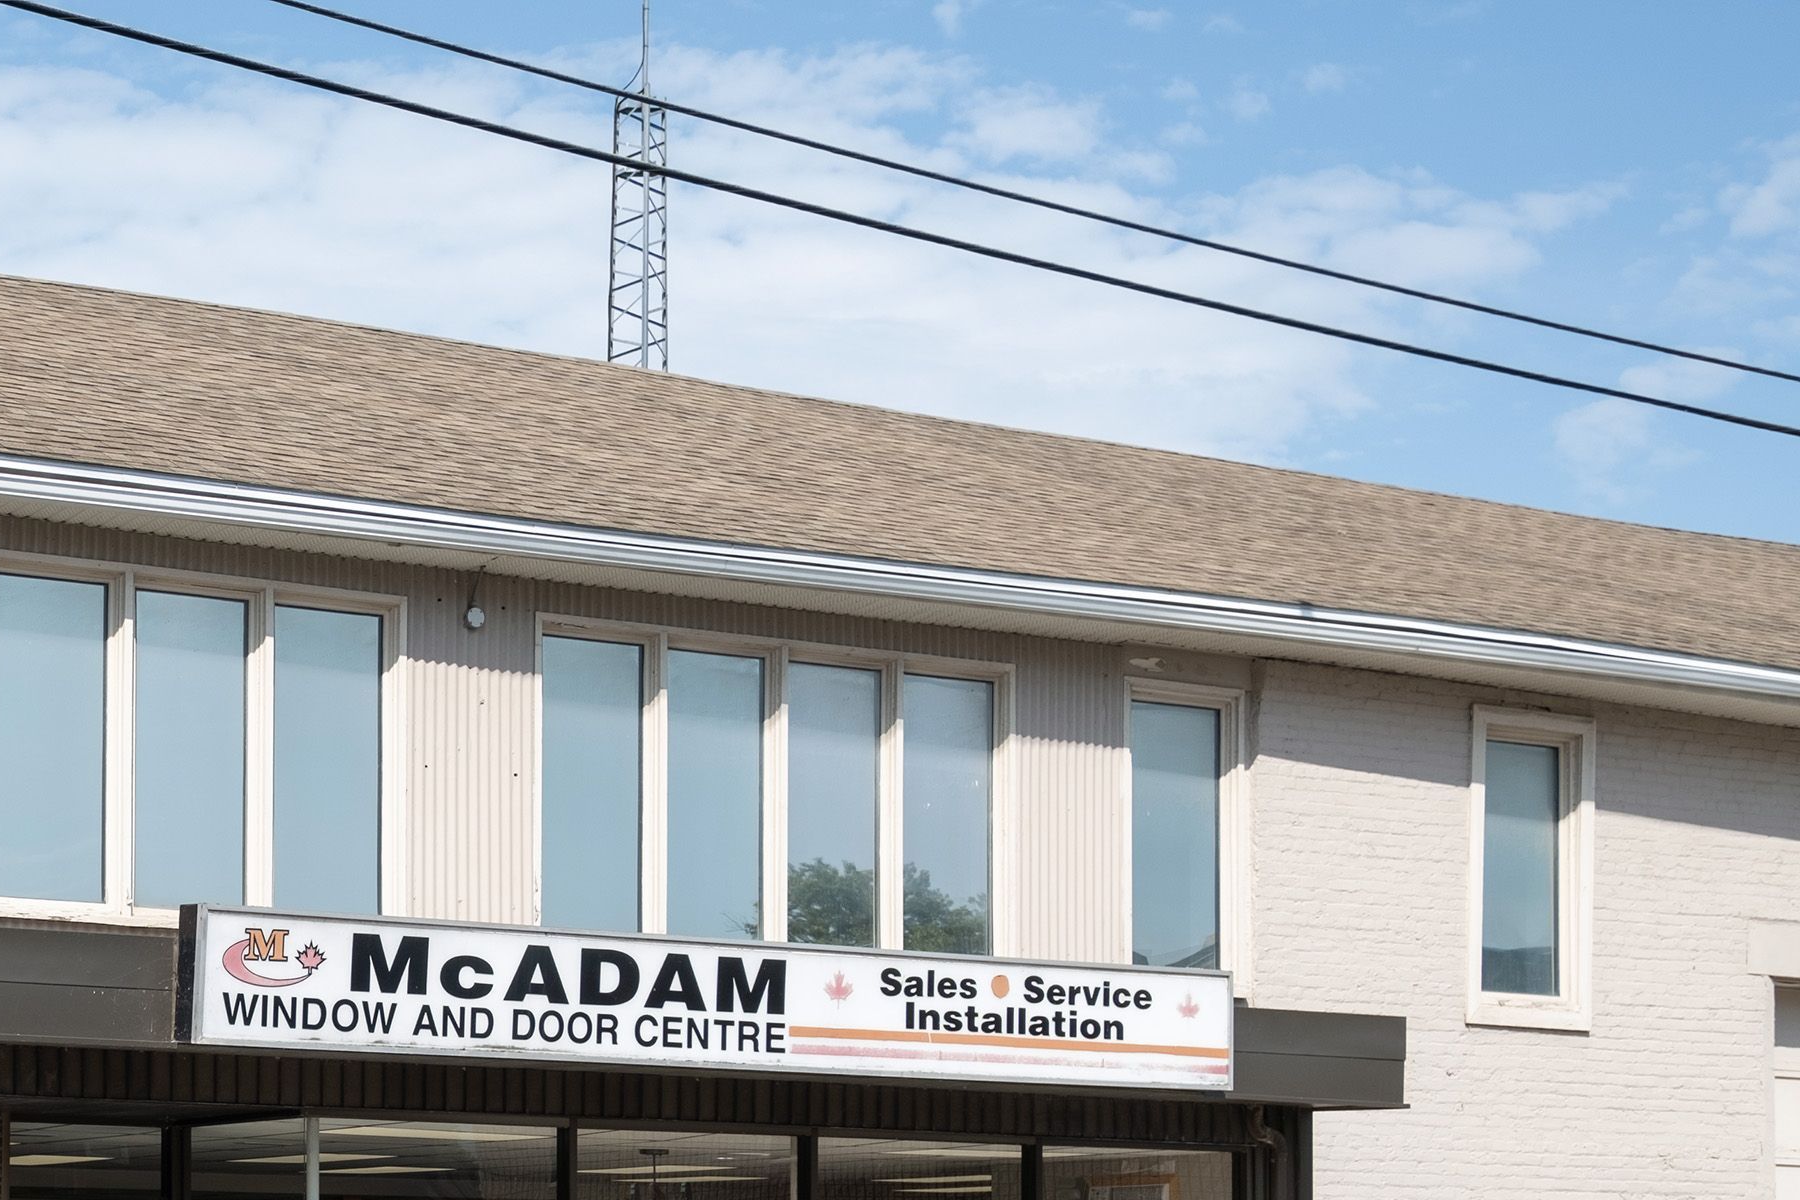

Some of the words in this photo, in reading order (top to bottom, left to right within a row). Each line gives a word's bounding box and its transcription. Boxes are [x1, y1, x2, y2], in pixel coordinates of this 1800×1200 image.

[244, 928, 290, 962] M
[349, 932, 787, 1015] McADAM
[879, 967, 978, 999] Sales
[1023, 975, 1153, 1010] Service
[222, 991, 398, 1034] WINDOW
[412, 1004, 495, 1039] AND
[511, 1008, 618, 1045] DOOR
[634, 1014, 786, 1054] CENTRE
[905, 1001, 1125, 1041] Installation
